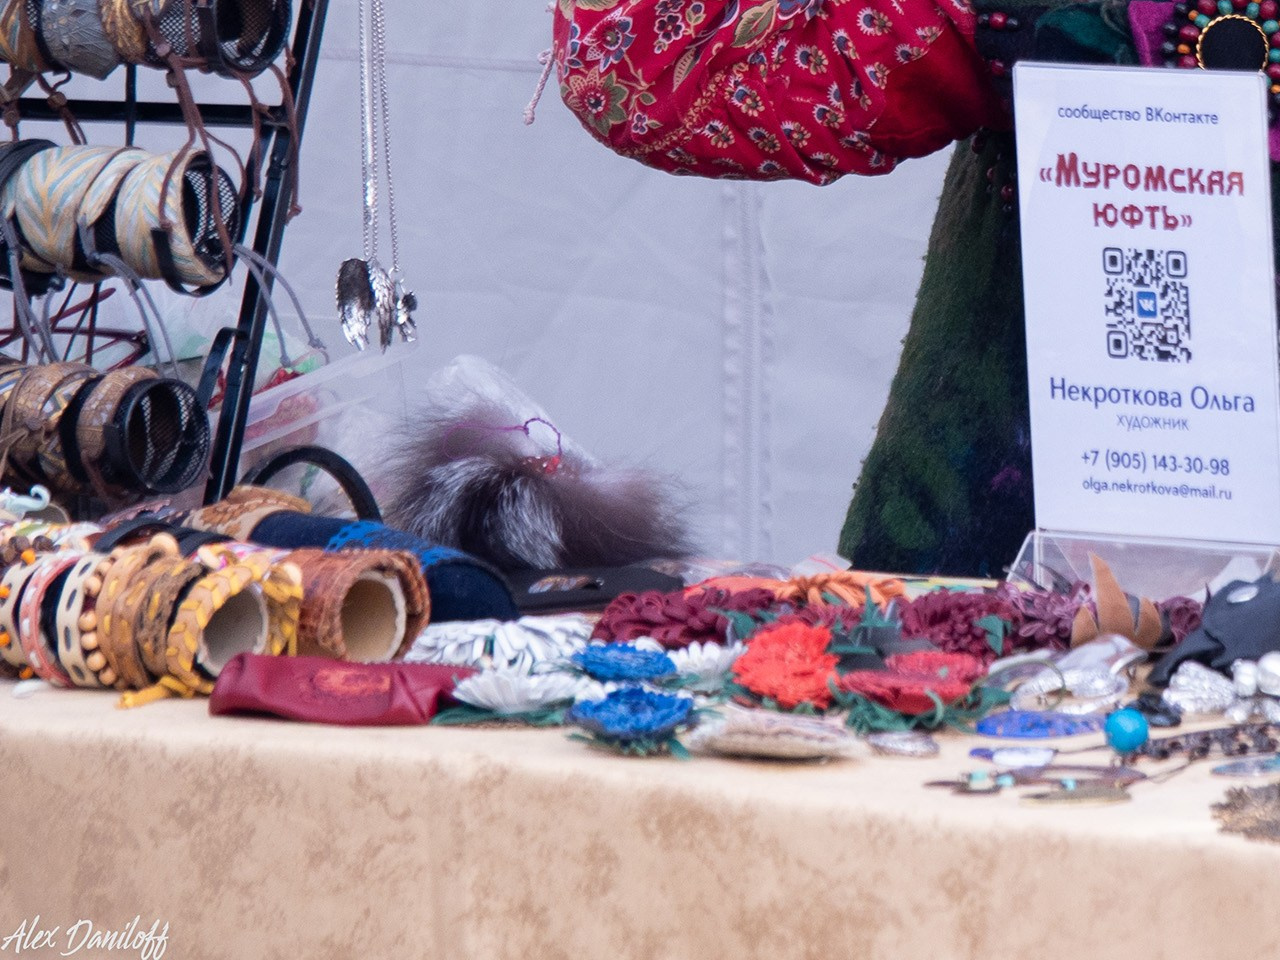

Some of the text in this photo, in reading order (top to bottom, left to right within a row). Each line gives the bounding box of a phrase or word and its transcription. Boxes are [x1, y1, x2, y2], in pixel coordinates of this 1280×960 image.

[1057, 105, 1219, 125] сообщество ВКонтакте
[1050, 377, 1255, 413] Некроткова Ольга
[1116, 414, 1190, 431] художник
[1081, 449, 1230, 476] +7 (905) 143-30-98
[1082, 477, 1232, 500] olga.nekrotkova@mail.ru
